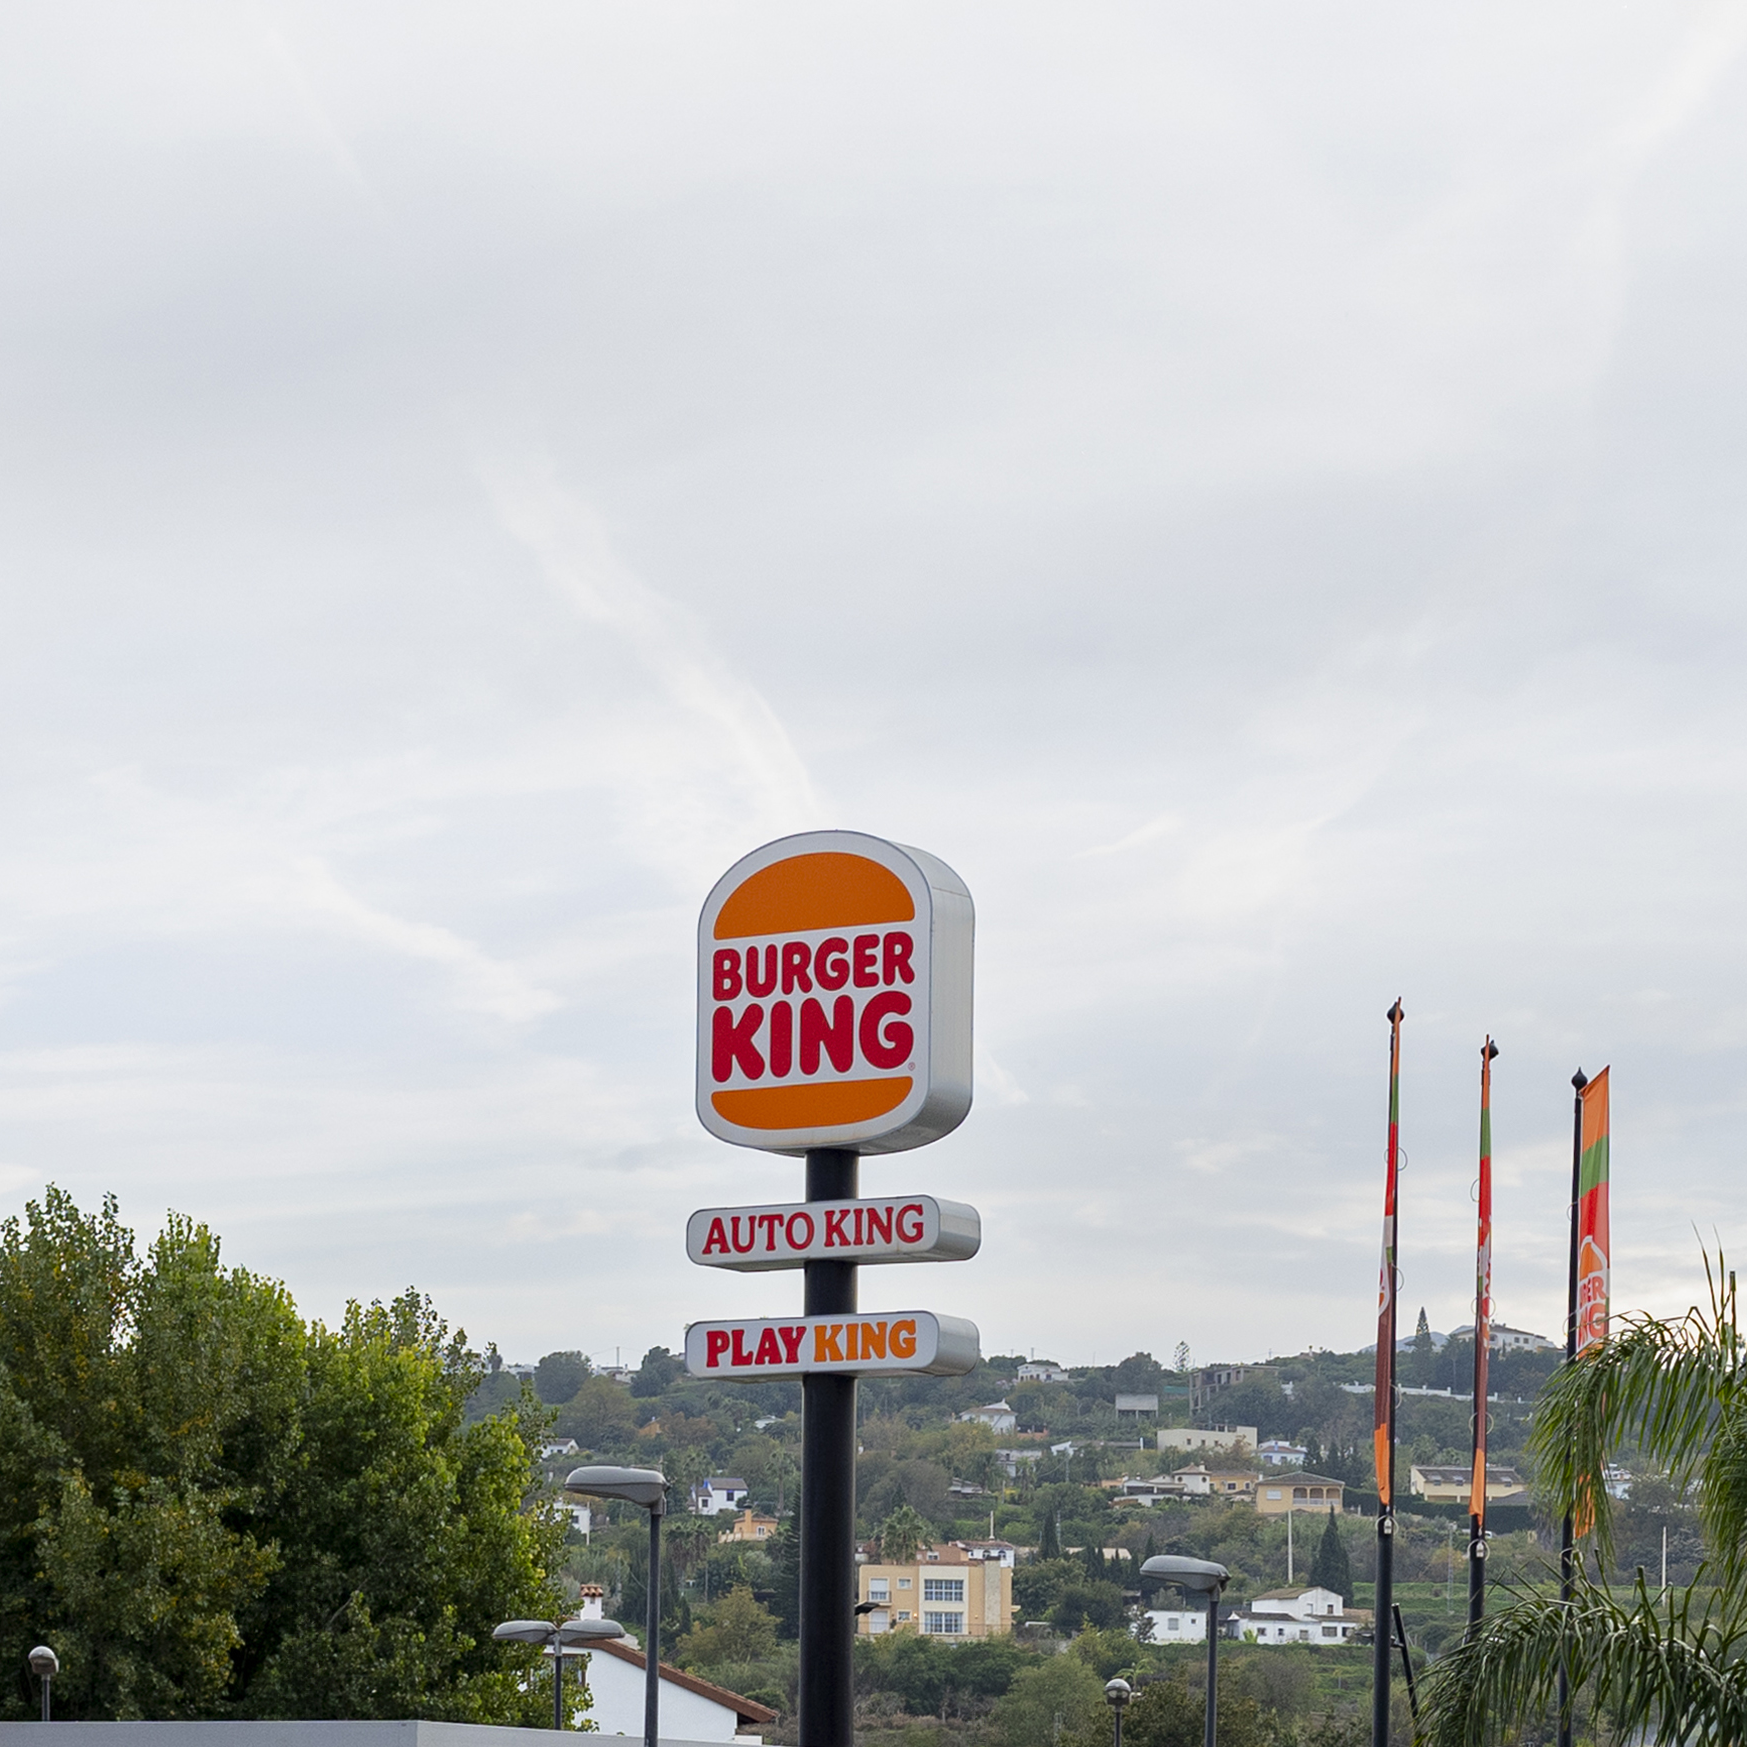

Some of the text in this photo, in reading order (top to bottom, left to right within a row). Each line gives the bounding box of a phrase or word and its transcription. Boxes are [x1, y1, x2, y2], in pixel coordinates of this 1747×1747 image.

[713, 931, 916, 1001] BURGER
[711, 991, 914, 1083] KING
[702, 1204, 924, 1255] AUTO KING
[706, 1319, 917, 1368] PLAY KING
